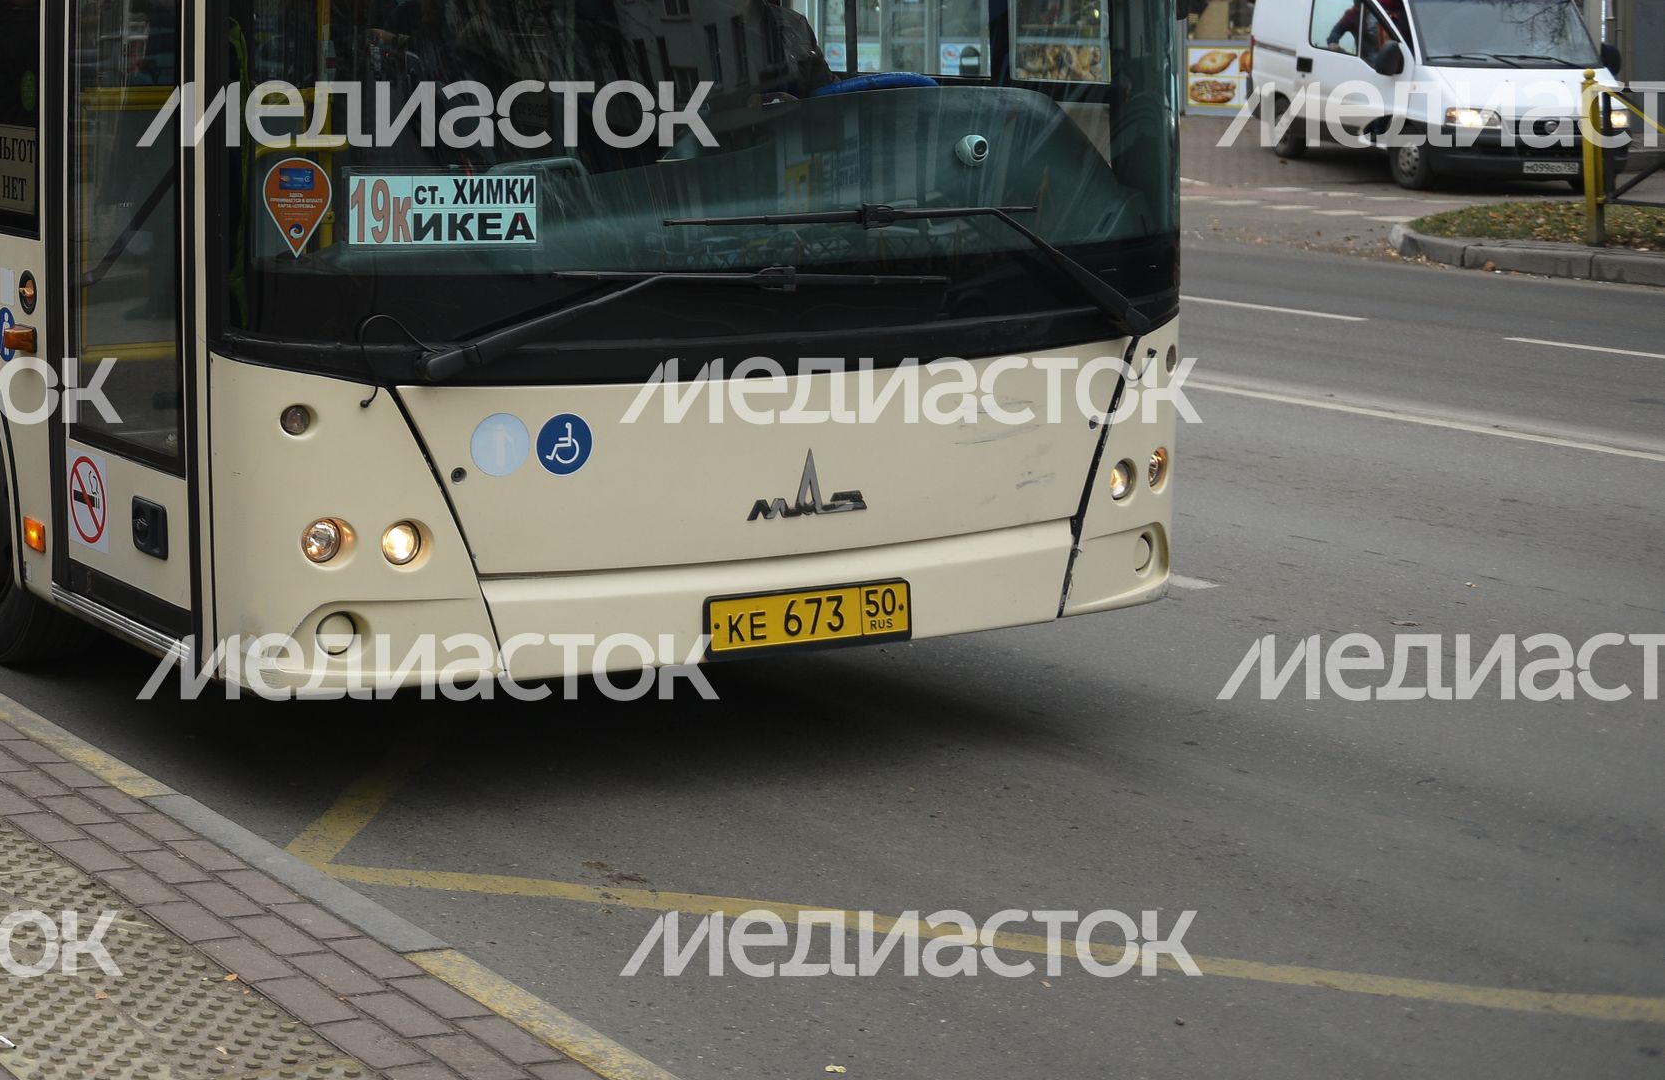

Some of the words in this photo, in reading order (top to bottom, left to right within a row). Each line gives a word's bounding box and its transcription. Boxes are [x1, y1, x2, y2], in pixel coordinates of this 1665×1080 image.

[2, 175, 27, 202] НЕТ
[452, 178, 535, 206] ХИМКИ
[413, 212, 535, 241] ИКЕА
[864, 587, 897, 618] 50
[728, 610, 767, 643] КЕ
[783, 594, 845, 637] 673
[869, 617, 894, 630] RUS
